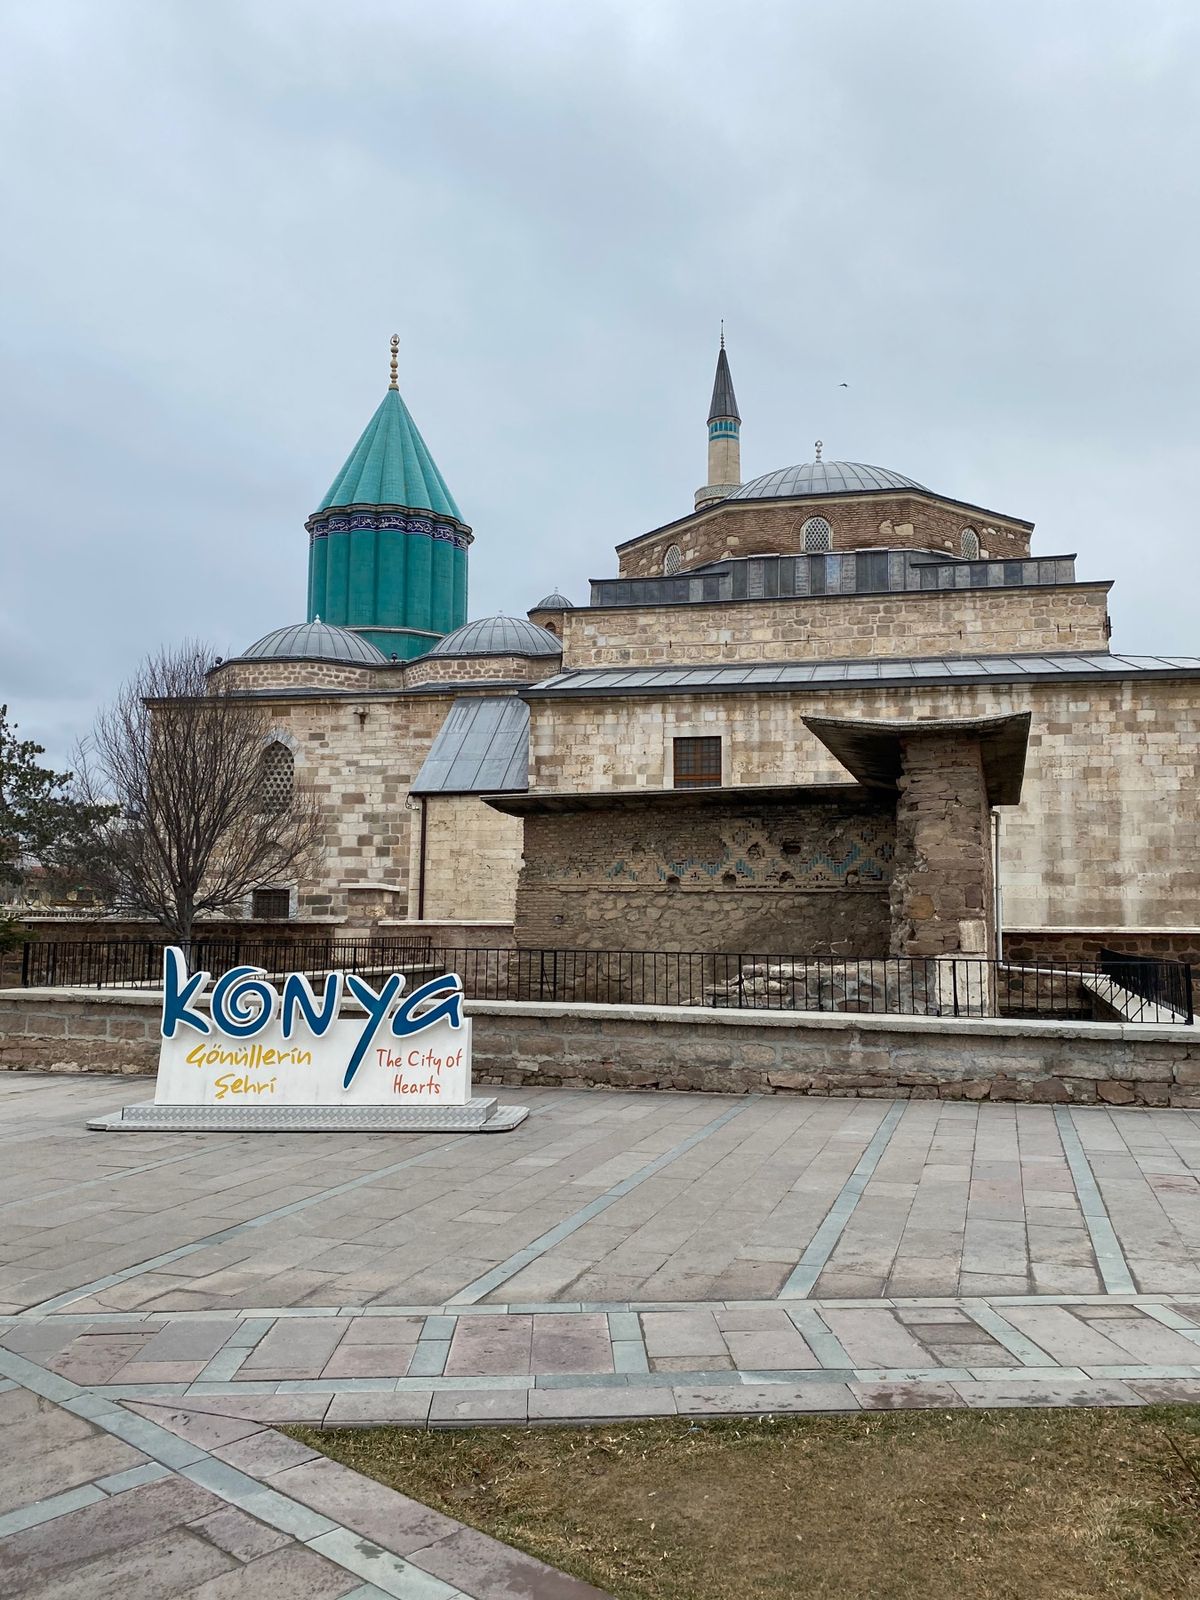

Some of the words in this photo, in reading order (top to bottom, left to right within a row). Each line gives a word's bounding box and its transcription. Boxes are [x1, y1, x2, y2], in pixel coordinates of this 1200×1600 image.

[185, 1043, 313, 1069] Gönüllerin
[376, 1048, 402, 1067] The
[407, 1048, 442, 1076] City
[445, 1047, 463, 1068] of
[214, 1073, 277, 1099] Şehri
[393, 1073, 441, 1095] Hearts
